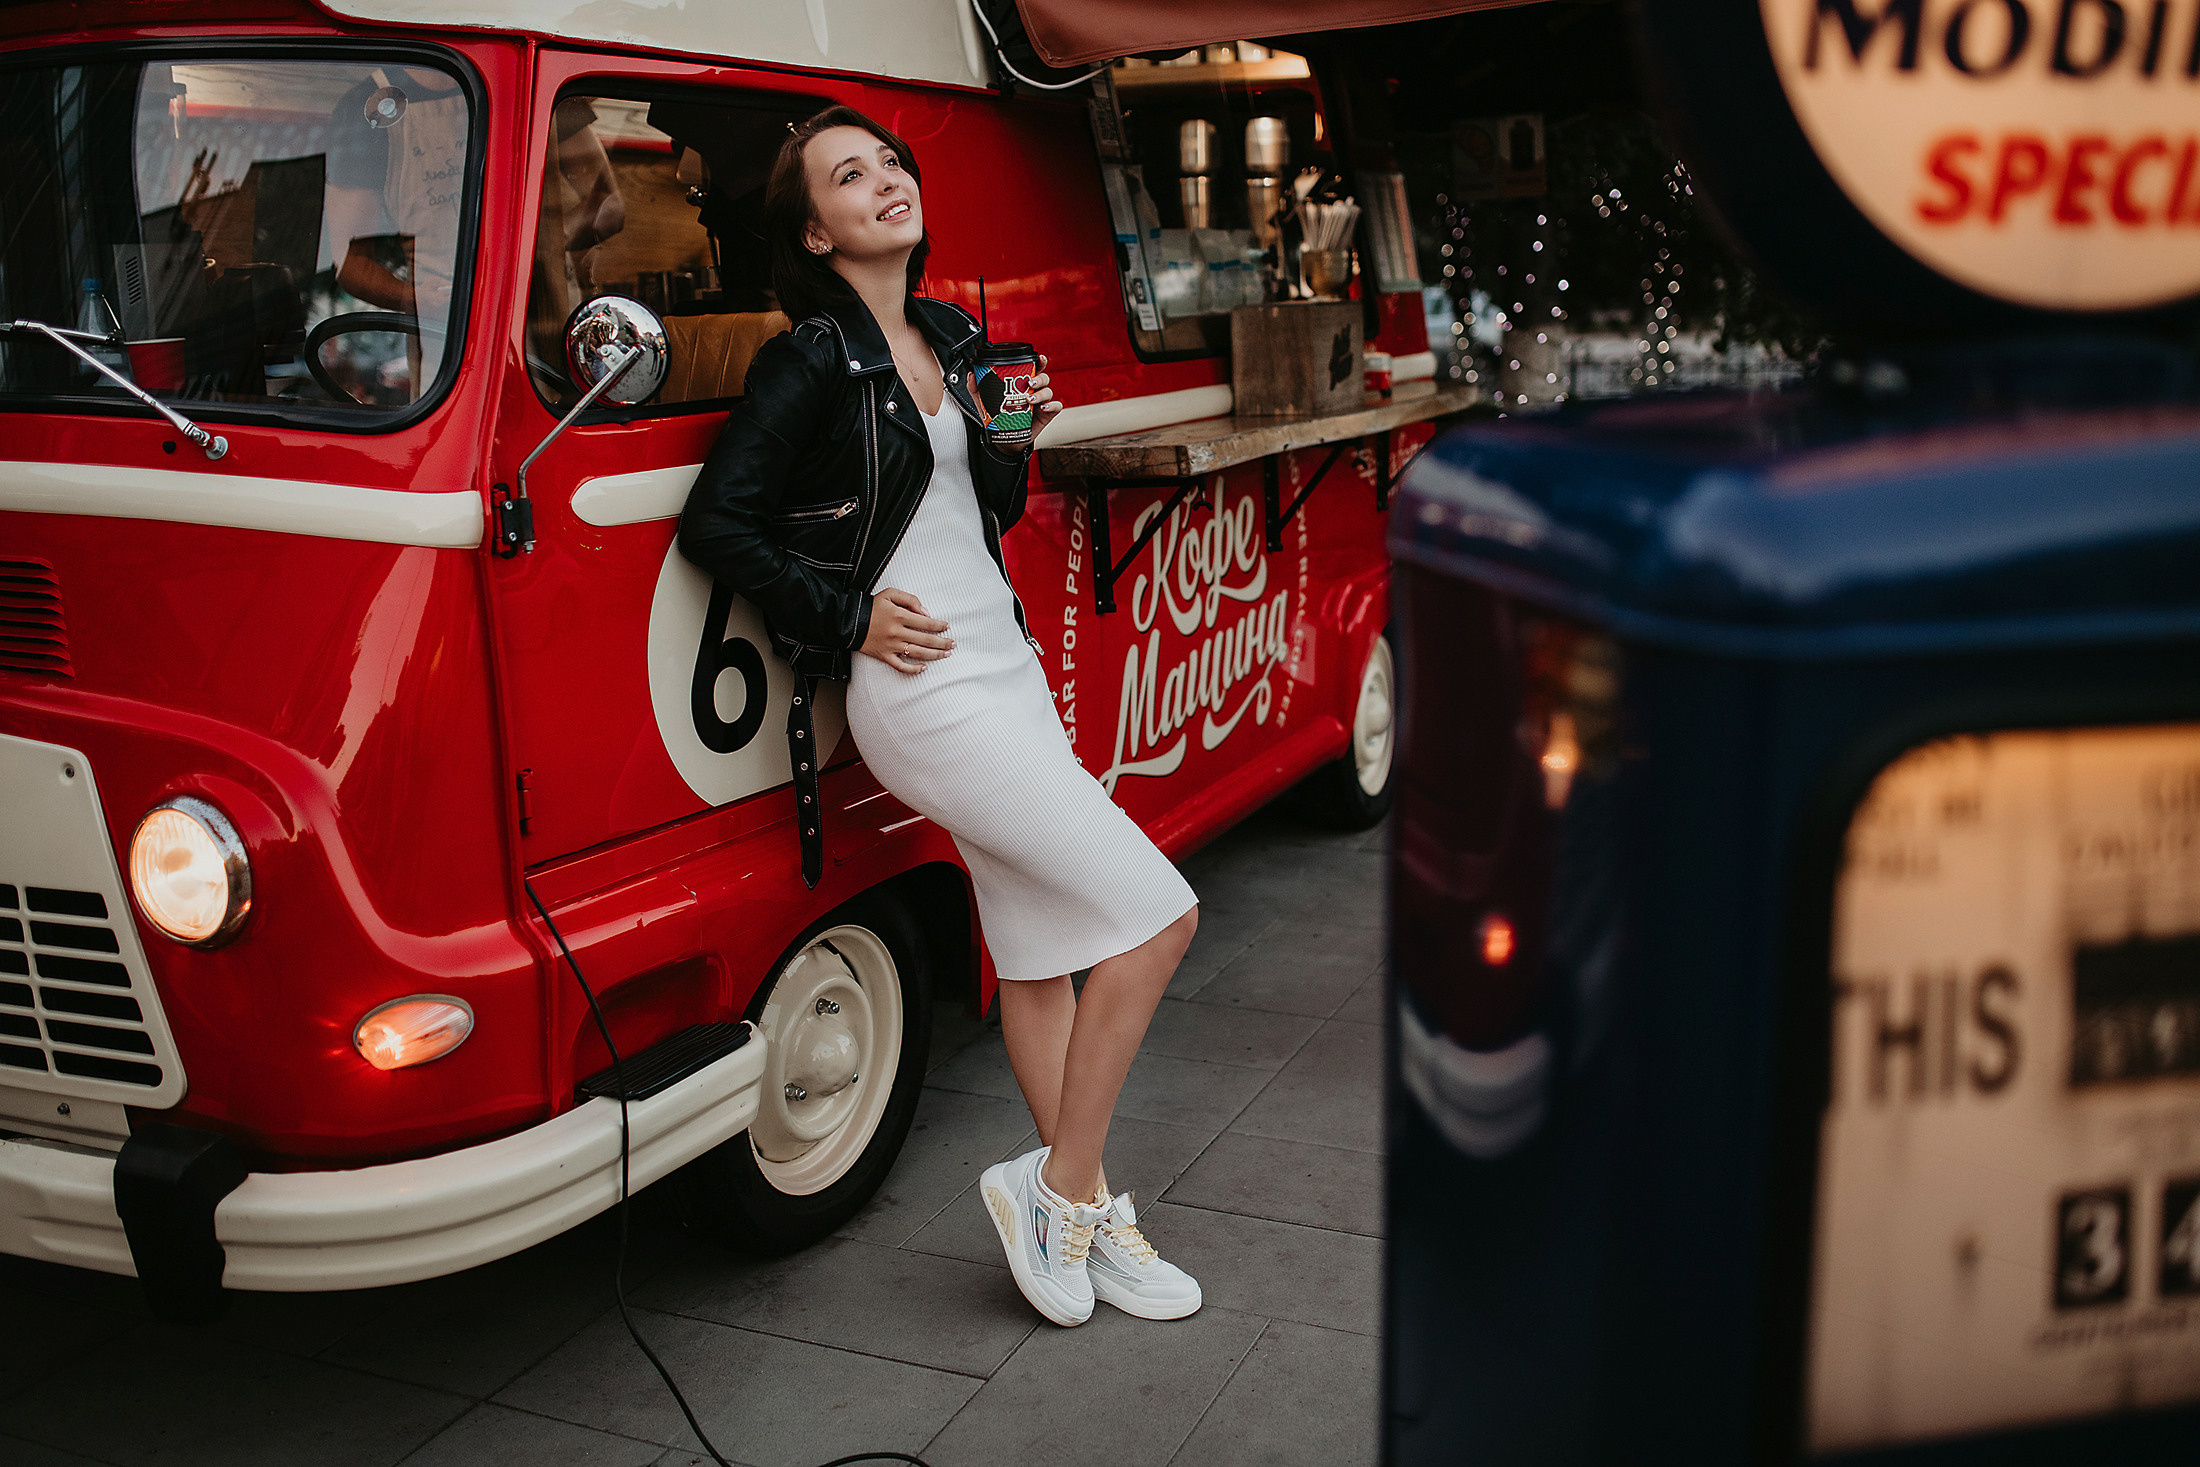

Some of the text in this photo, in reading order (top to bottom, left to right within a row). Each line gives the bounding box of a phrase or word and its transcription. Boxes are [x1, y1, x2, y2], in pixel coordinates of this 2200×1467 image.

[1917, 132, 2200, 228] SPECI
[1062, 494, 1089, 750] BAR FOR PEOPL
[1132, 475, 1268, 636] Кофе
[1295, 556, 1308, 624] REAL
[691, 577, 768, 754] 6
[1099, 589, 1289, 799] Машина
[1276, 628, 1304, 728] COFFEE
